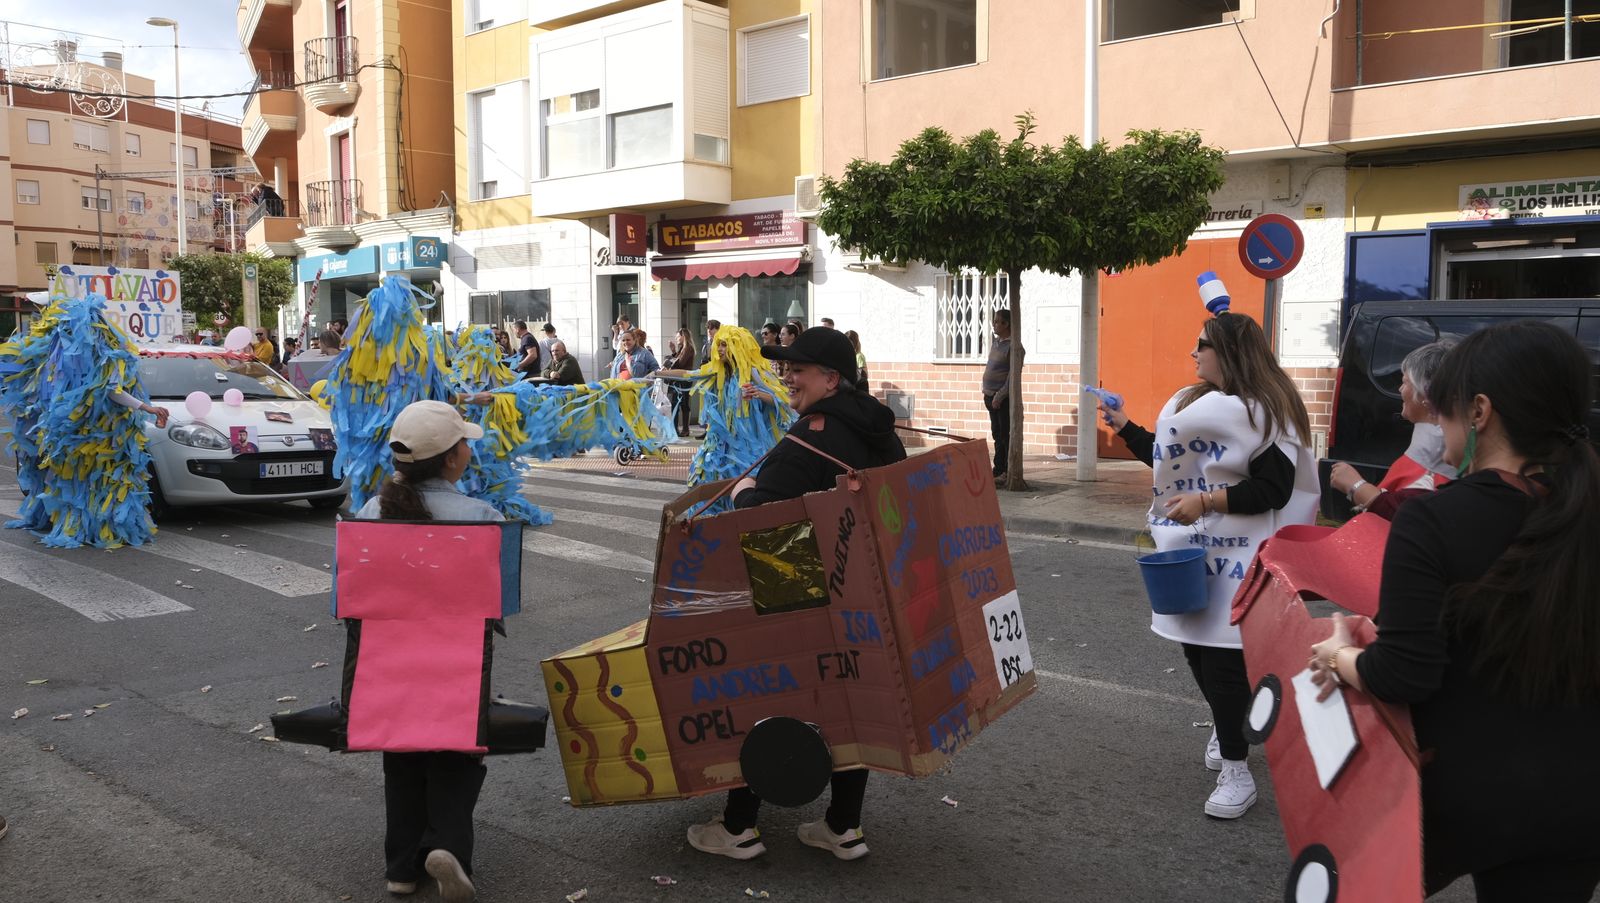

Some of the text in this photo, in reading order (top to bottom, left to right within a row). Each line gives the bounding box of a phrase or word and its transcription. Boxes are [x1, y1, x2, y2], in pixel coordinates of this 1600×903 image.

[1205, 205, 1253, 221] urrería
[1518, 196, 1548, 211] LOS
[682, 221, 743, 239] TABACOS
[1153, 436, 1227, 462] ABÓN
[268, 463, 319, 476] 4111 HCL
[960, 566, 999, 599] 2023
[1206, 557, 1244, 580] AVA
[841, 609, 883, 648] ISA
[990, 610, 1022, 642] 2-22
[658, 637, 728, 676] FORD
[816, 649, 861, 682] FIAT
[1001, 654, 1025, 686] PSC
[692, 662, 800, 705] ANDREA
[678, 706, 747, 745] OPEL
